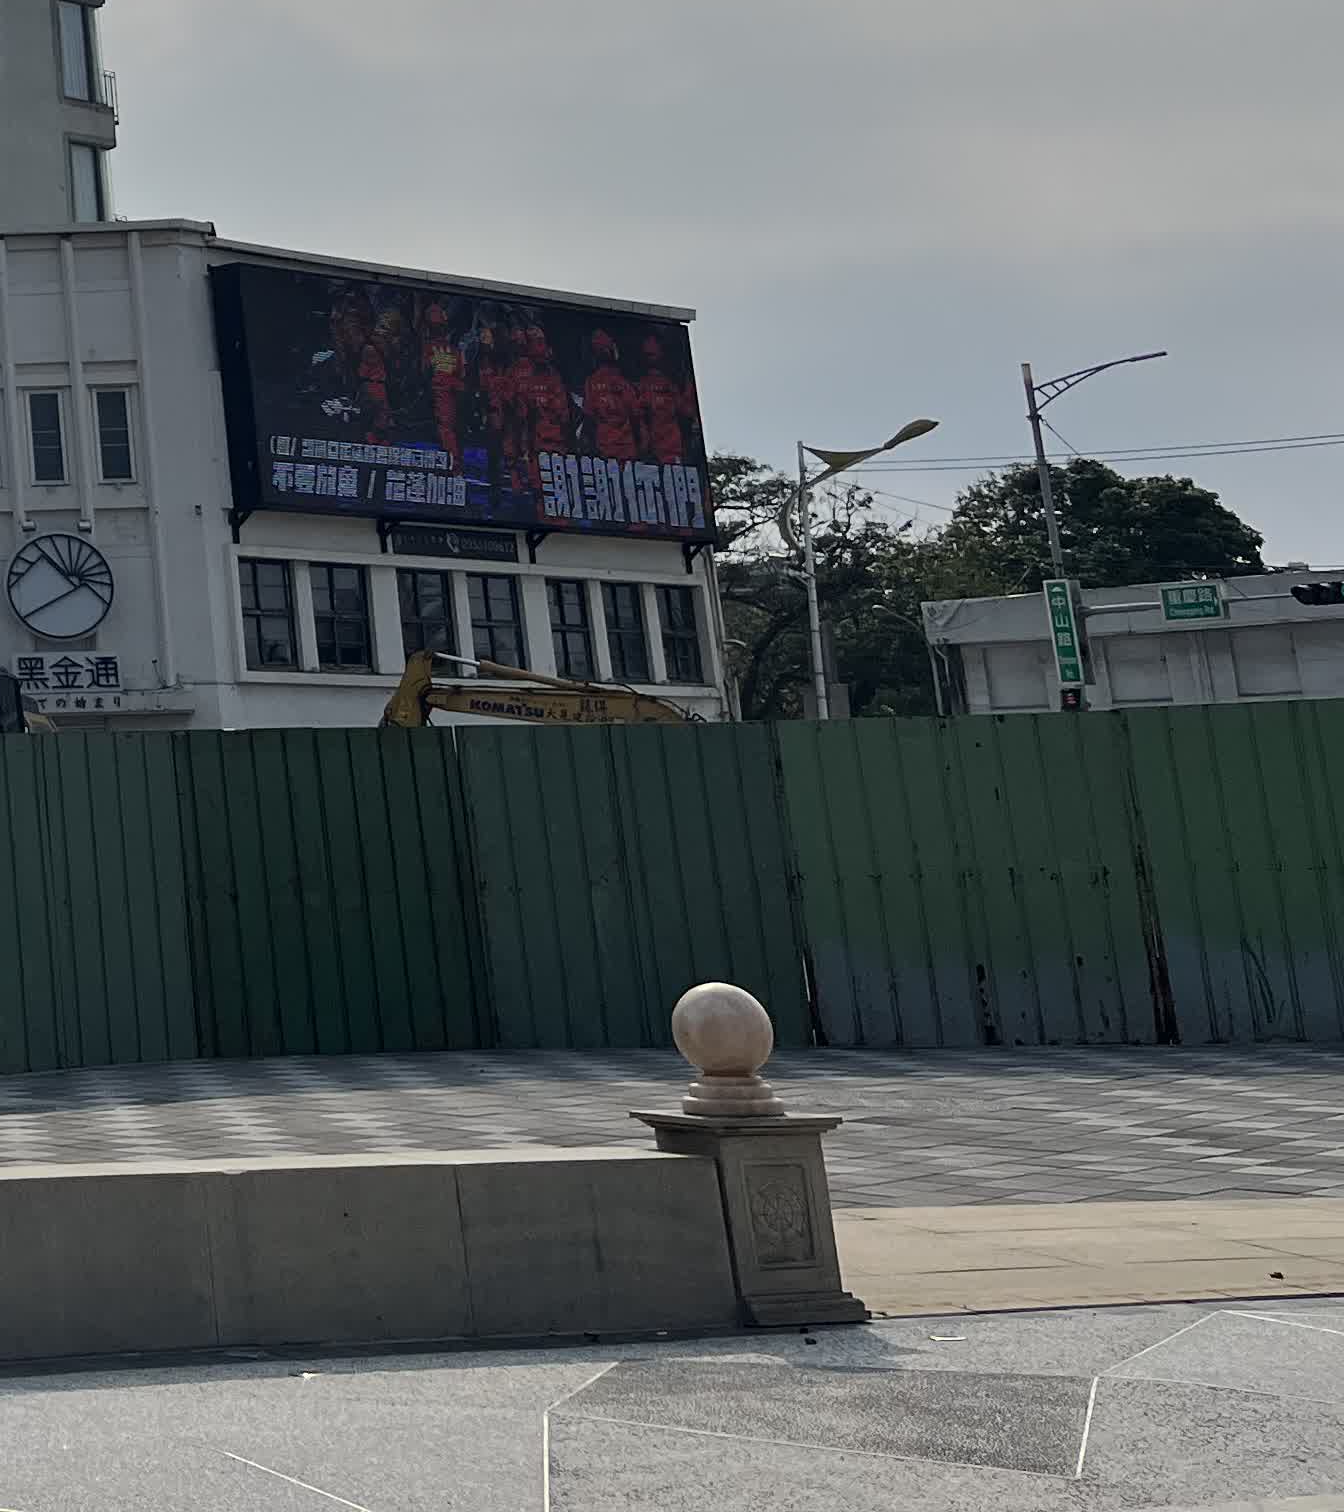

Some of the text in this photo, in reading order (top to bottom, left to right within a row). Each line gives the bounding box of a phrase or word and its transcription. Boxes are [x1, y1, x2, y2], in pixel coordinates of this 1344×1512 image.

[538, 451, 705, 529] 謝謝你們
[1051, 595, 1073, 647] 中山路
[16, 655, 121, 689] 黑金通
